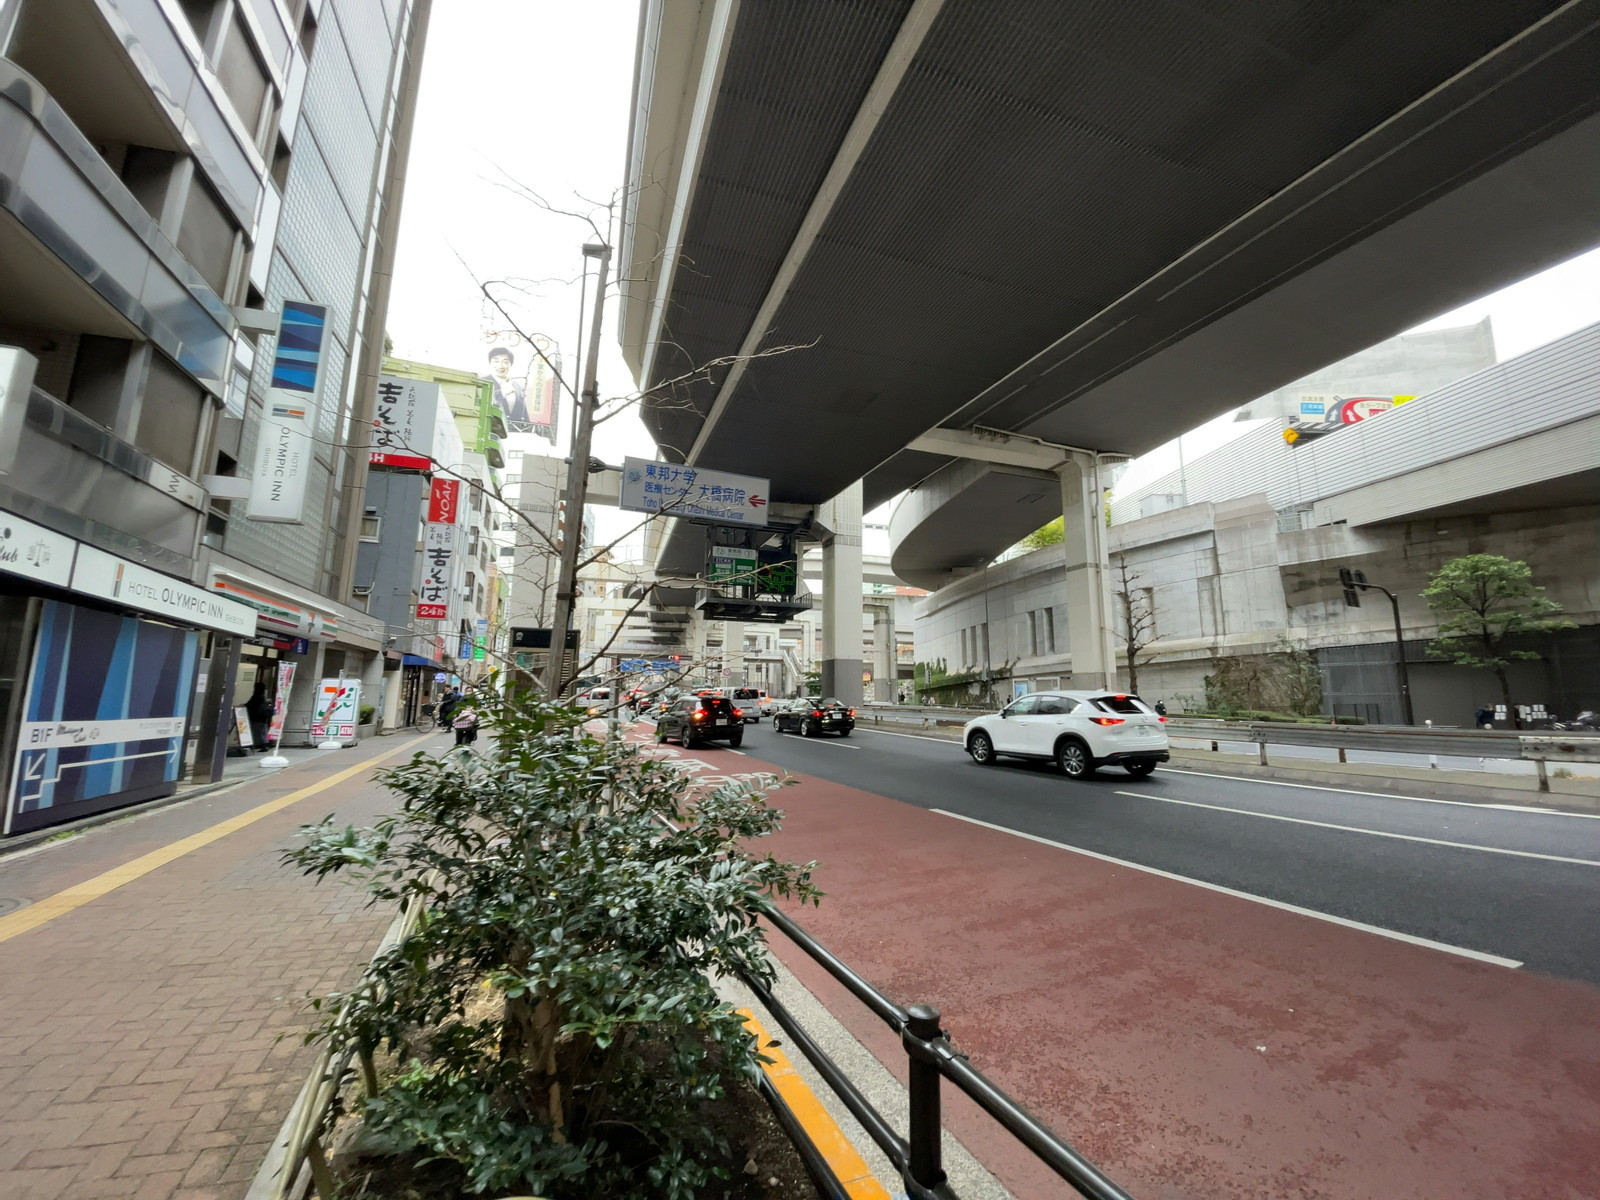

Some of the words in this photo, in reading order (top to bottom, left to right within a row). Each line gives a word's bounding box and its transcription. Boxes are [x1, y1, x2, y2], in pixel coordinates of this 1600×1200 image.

[274, 428, 290, 477] OLYMPIC
[290, 452, 299, 476] HOTEL
[645, 464, 696, 485] 東邦大学
[271, 481, 283, 501] INN
[439, 480, 453, 524] NOAH
[643, 496, 657, 508] Toho
[644, 482, 693, 497] 医療センター
[699, 485, 746, 506] 大橋病院
[421, 547, 452, 602] 吉そば
[128, 581, 158, 601] HOTEL
[161, 587, 206, 614] OLYMPIC
[207, 602, 224, 620] INN
[31, 728, 53, 743] B1F
